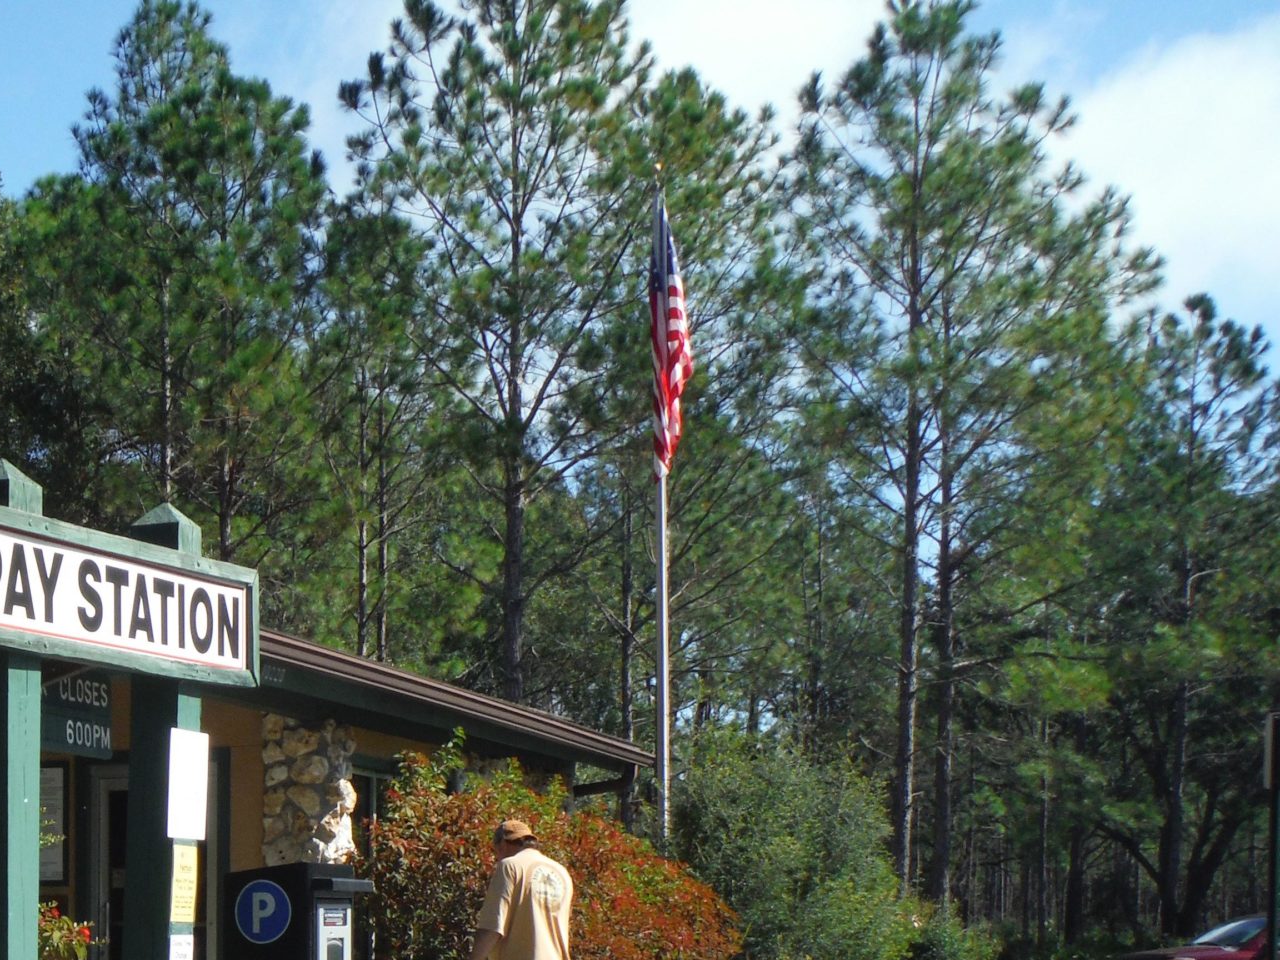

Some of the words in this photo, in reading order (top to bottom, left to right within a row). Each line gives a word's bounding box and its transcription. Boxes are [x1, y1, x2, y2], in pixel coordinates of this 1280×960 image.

[77, 558, 240, 660] STATION
[59, 677, 108, 708] CLOSES
[252, 892, 276, 934] P
